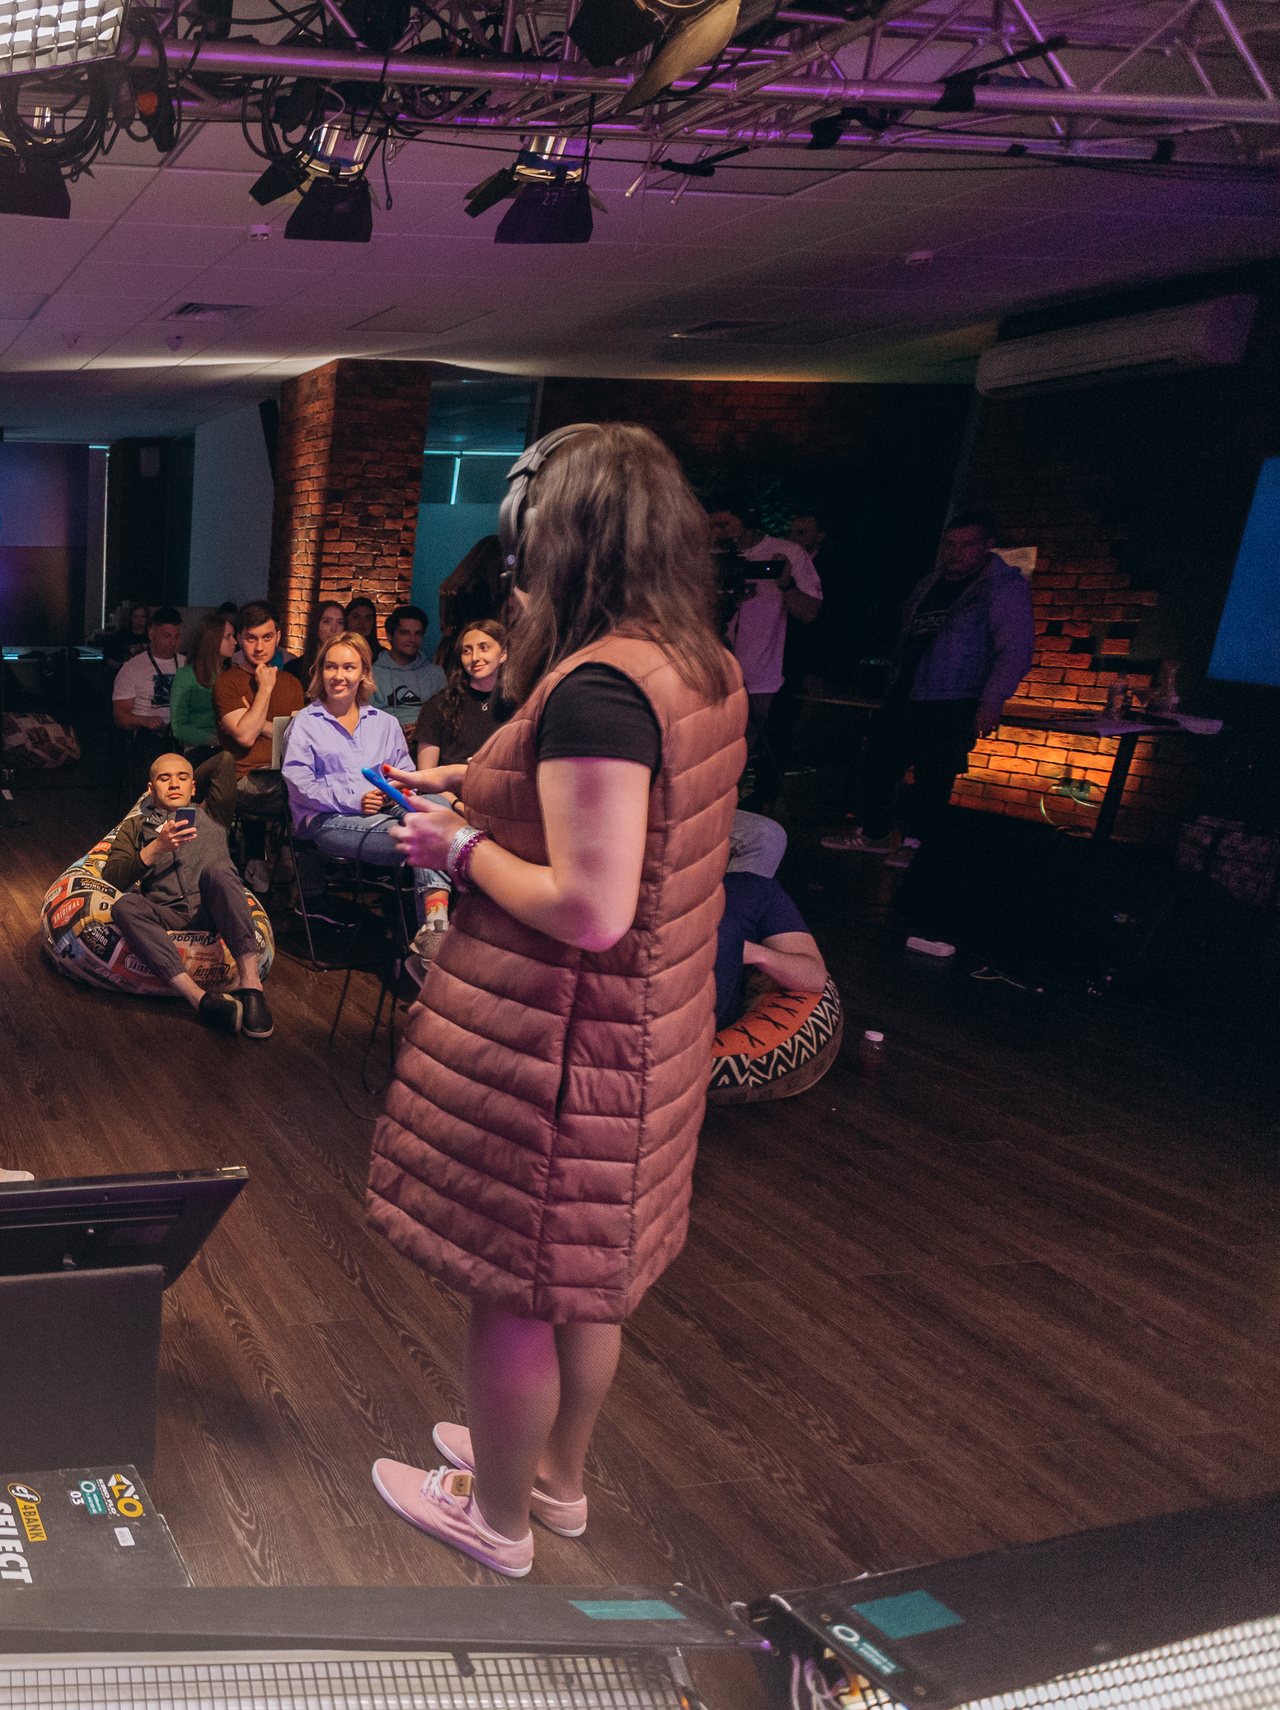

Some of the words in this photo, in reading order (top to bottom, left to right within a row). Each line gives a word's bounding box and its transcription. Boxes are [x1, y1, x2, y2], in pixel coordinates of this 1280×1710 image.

[541, 192, 559, 206] 27
[70, 1490, 85, 1506] 03
[21, 1504, 45, 1540] 4BANK
